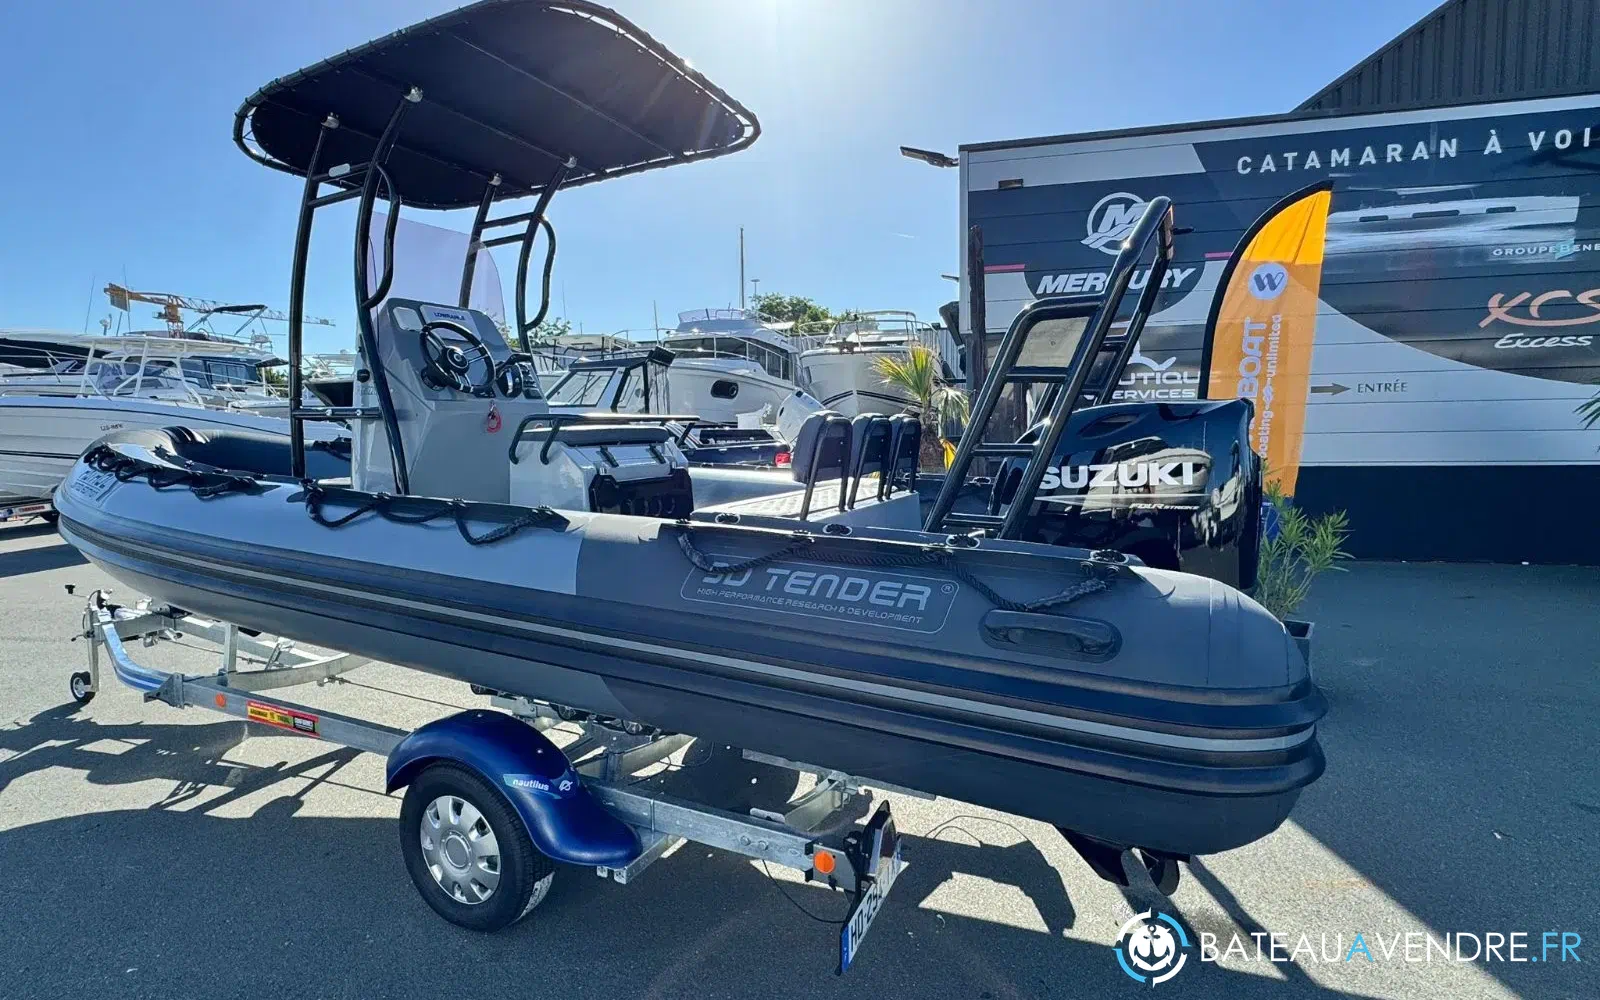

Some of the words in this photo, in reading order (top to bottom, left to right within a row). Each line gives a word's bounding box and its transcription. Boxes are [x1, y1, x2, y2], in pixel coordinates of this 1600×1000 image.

[1236, 138, 1458, 175] CATAMARAN
[1483, 129, 1502, 155] À
[1035, 267, 1197, 295] MERURY
[1494, 333, 1594, 349] Excess
[1111, 388, 1196, 400] ERVICES
[1357, 379, 1408, 393] ENTRÉE
[1039, 461, 1194, 490] SUZUKI
[765, 567, 932, 611] TENDER
[696, 587, 719, 597] HIGH
[719, 590, 785, 605] PERFORMANCE
[785, 598, 838, 613] RESEARCH
[846, 606, 923, 624] DEVELOPMENT
[512, 779, 549, 791] nautilus
